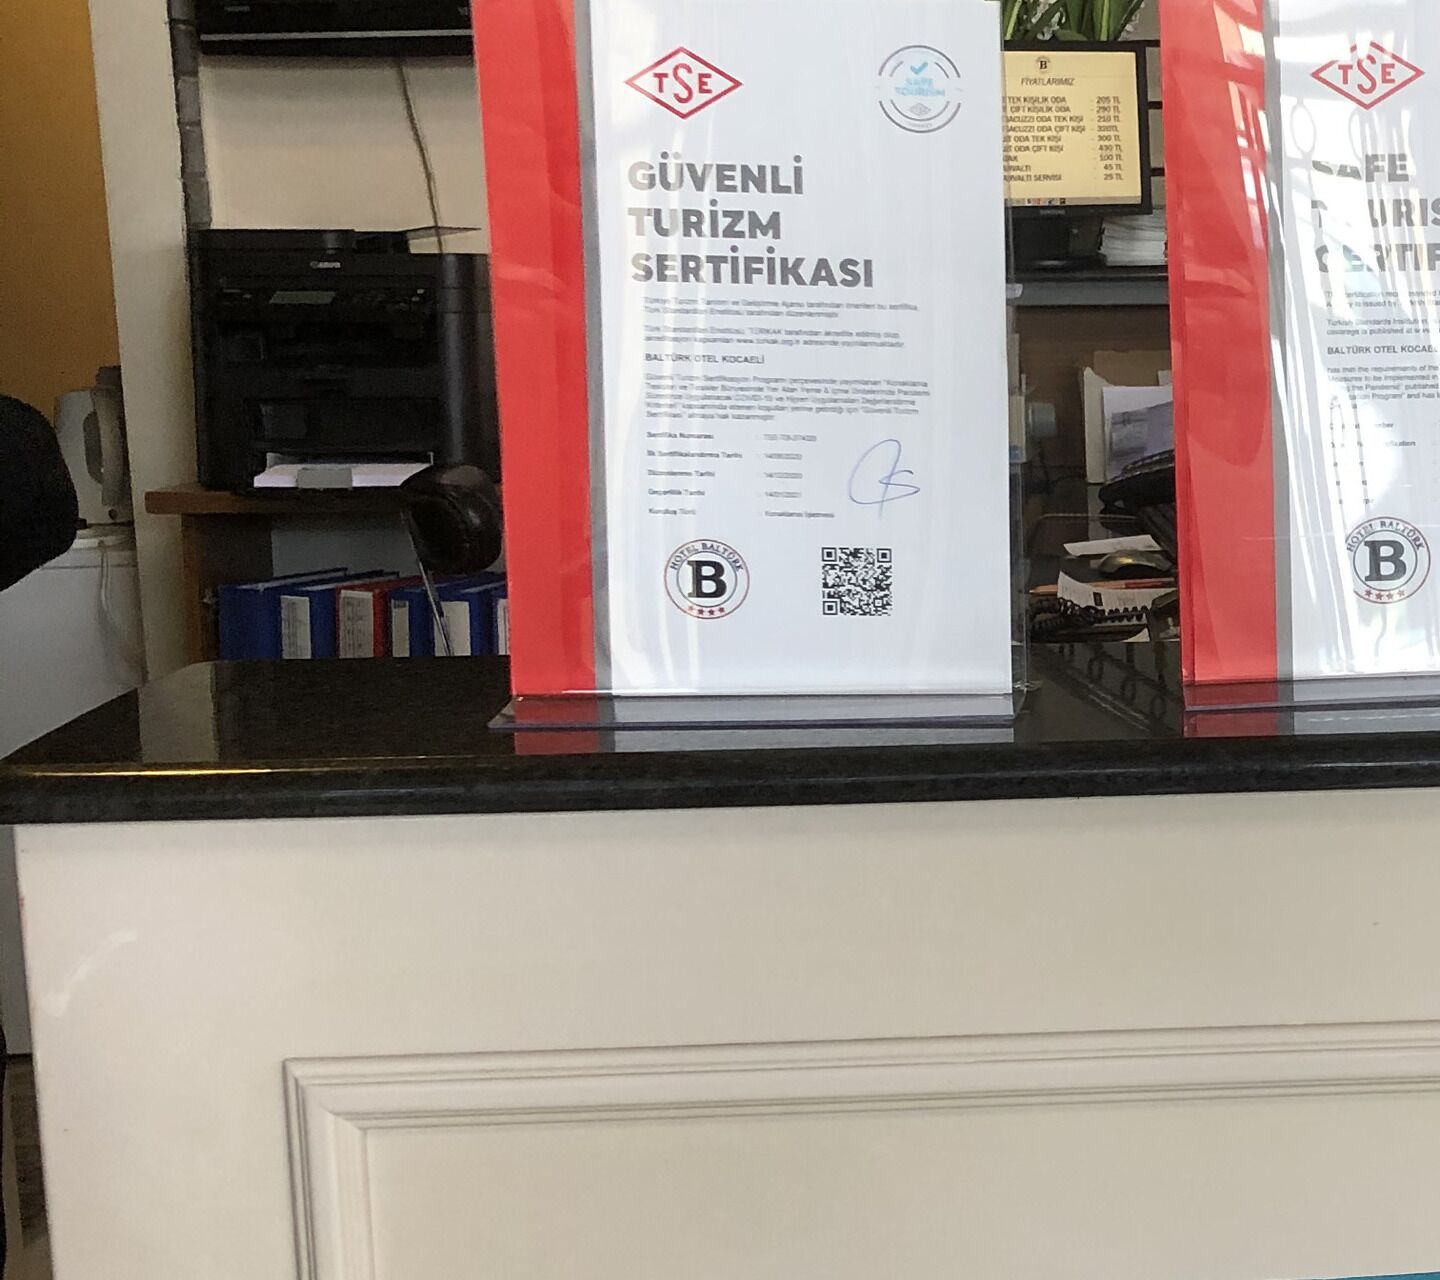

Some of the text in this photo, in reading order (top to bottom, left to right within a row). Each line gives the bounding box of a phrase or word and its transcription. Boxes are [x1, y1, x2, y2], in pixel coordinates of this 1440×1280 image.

[653, 63, 713, 104] TSE
[1338, 53, 1396, 94] TSE
[628, 151, 804, 195] GÜVENLİ
[628, 199, 781, 240] TURİZM
[631, 245, 873, 288] SERTİFİKASI
[645, 352, 692, 363] BALTÜRK
[721, 354, 765, 365] KOCAELİ
[1327, 344, 1371, 355] BALTÜRK
[1373, 346, 1398, 354] OTEL
[670, 542, 743, 571] HOTEL BALTÜRK
[1346, 520, 1425, 553] HOTEL BALTÜRK
[687, 560, 728, 599] B
[1364, 540, 1407, 582] B
